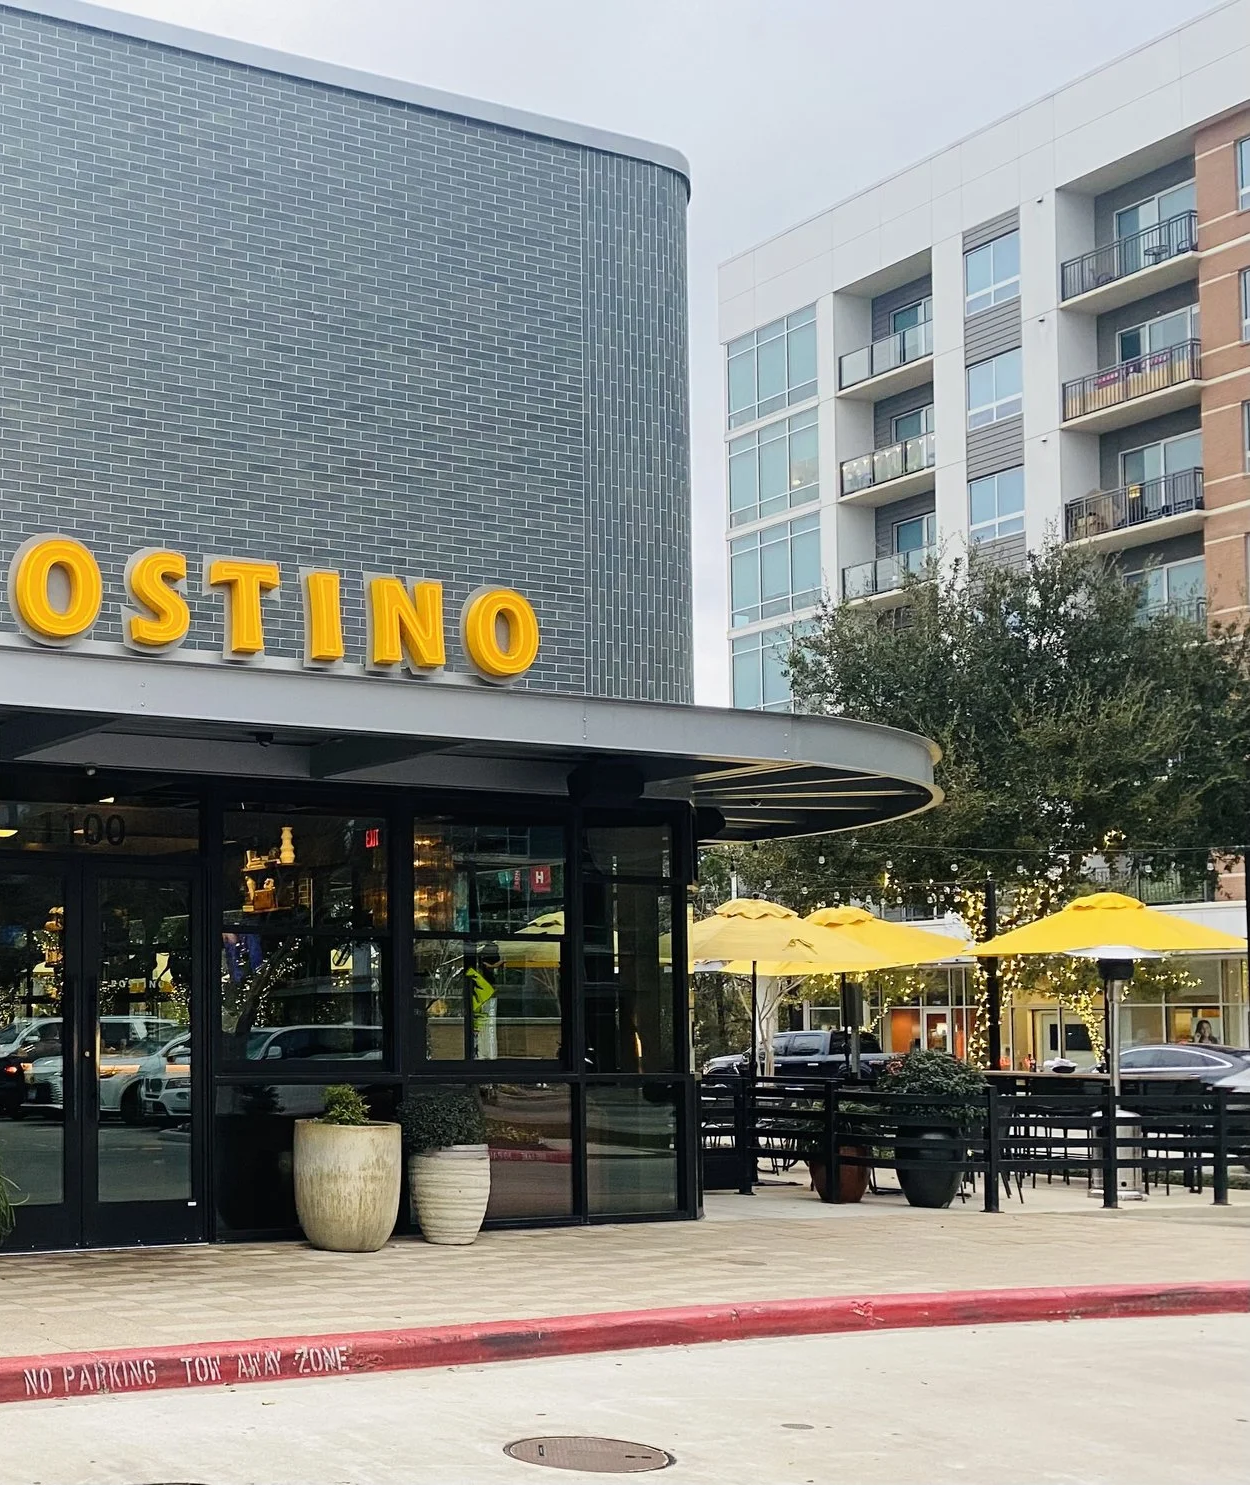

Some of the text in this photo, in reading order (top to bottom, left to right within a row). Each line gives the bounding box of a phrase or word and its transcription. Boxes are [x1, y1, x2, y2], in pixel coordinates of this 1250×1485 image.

[41, 811, 125, 845] 1100
[365, 828, 380, 848] EXIT
[23, 1367, 53, 1396] NO
[63, 1359, 157, 1393] PARKING
[180, 1355, 223, 1384] TOW
[237, 1350, 282, 1379] AWAY
[296, 1345, 351, 1374] ZONE
